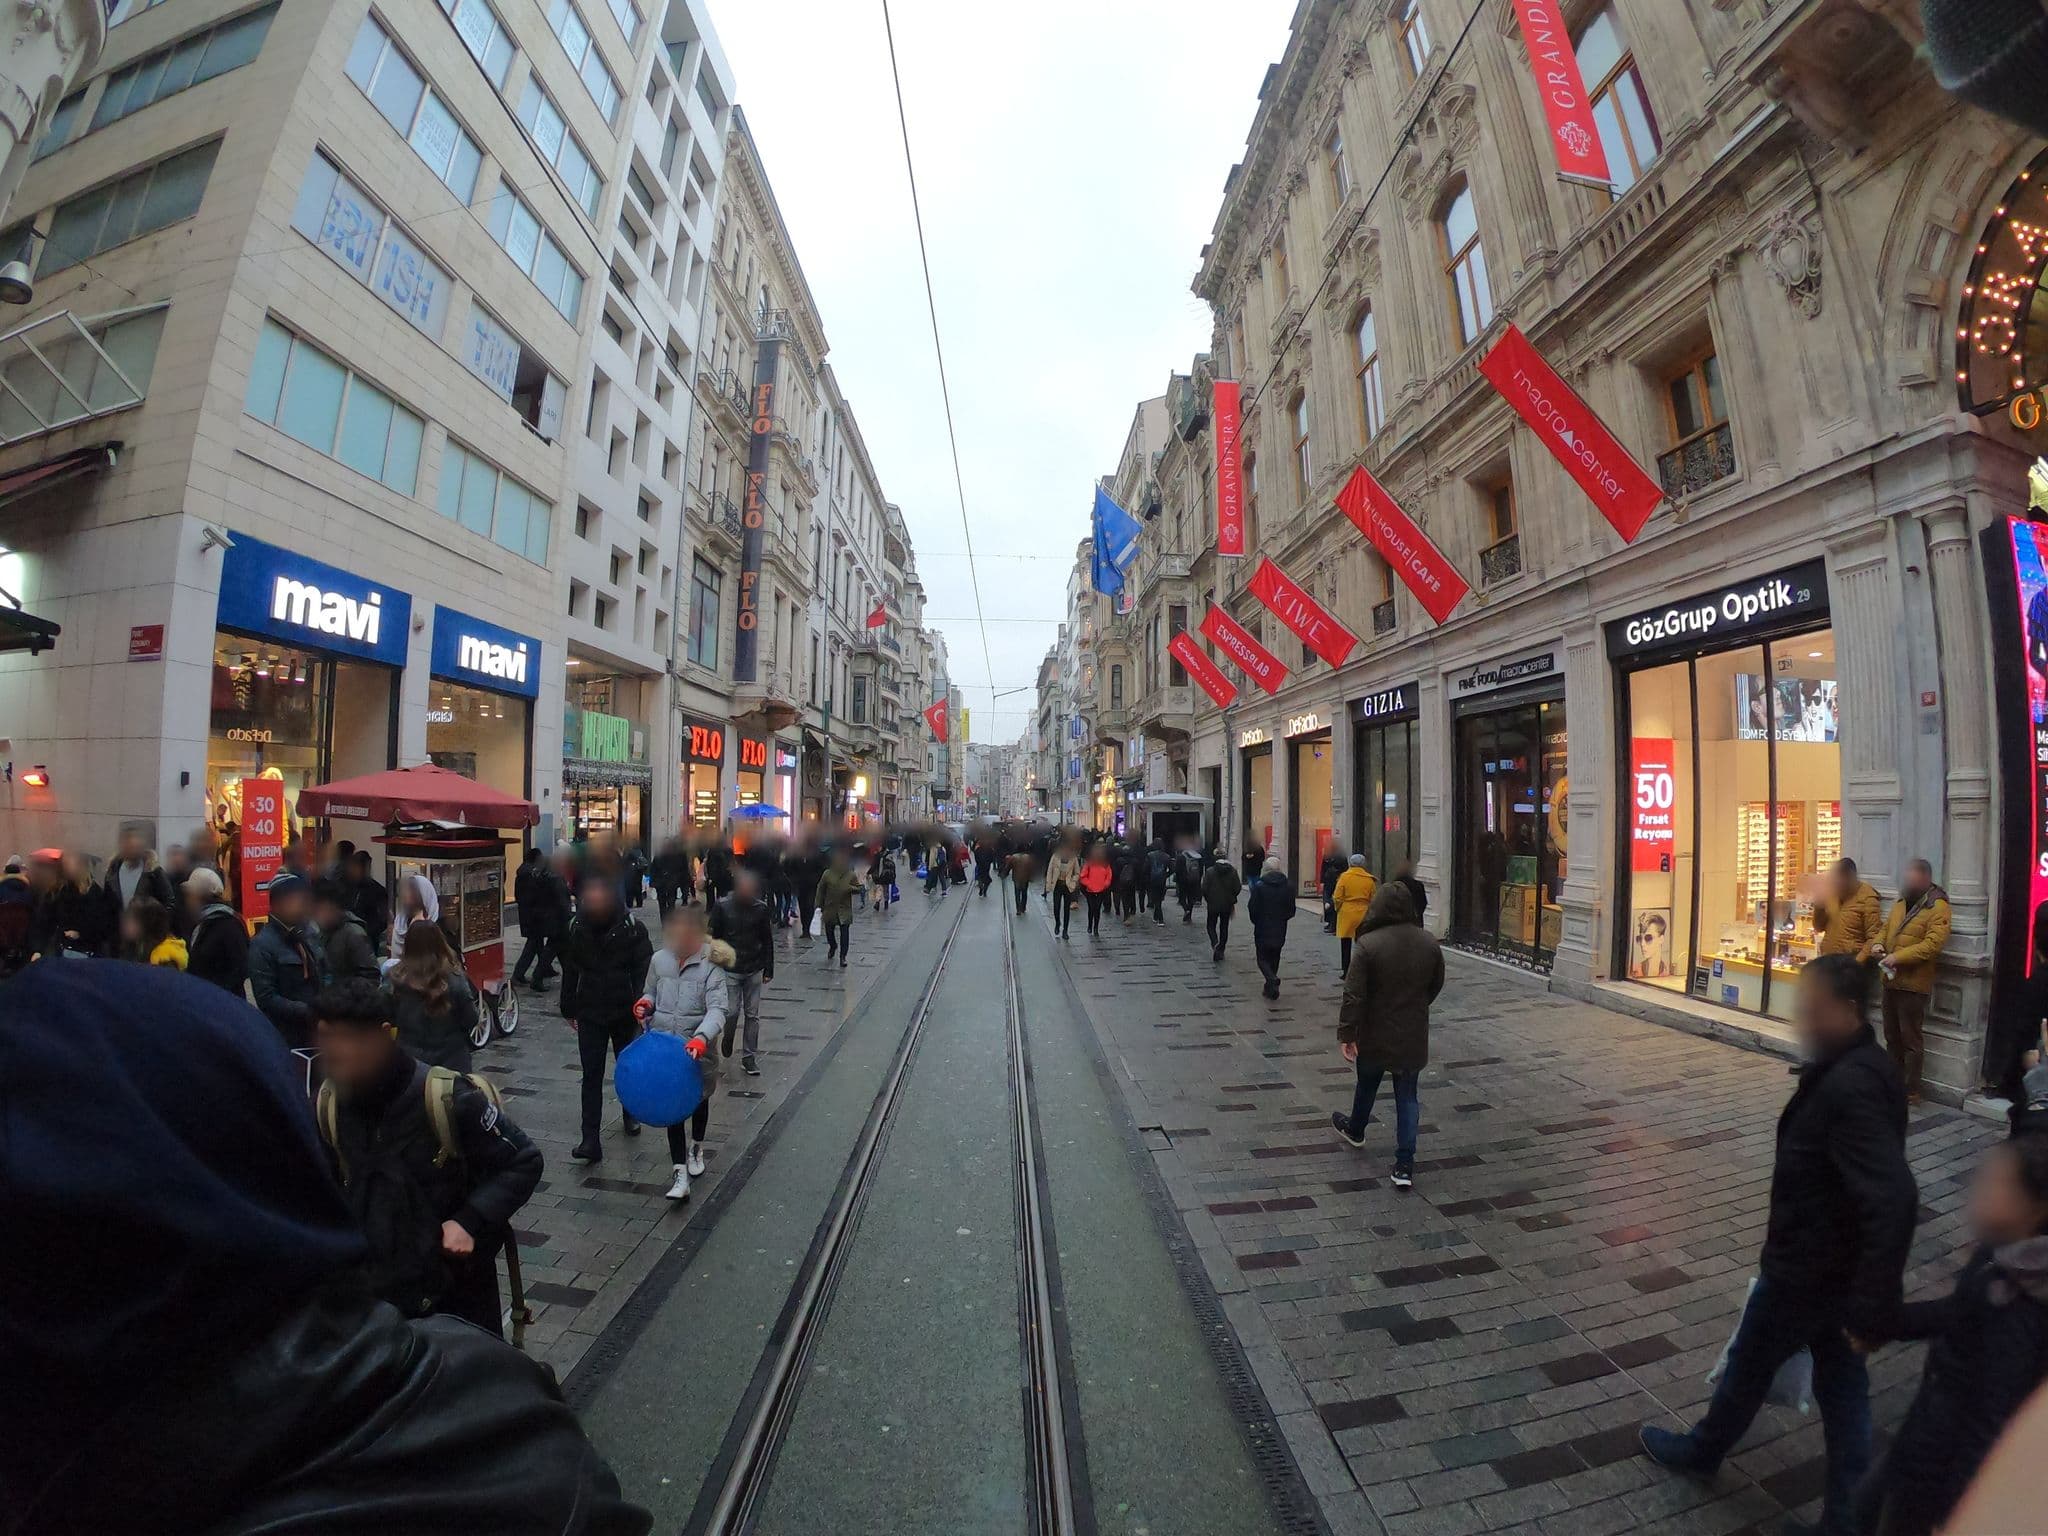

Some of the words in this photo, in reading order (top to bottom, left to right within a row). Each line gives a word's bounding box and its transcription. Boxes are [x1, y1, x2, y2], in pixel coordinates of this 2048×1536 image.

[1523, 0, 1576, 109] GRAND
[753, 383, 774, 435] FLO
[1512, 368, 1567, 432] macro
[1572, 439, 1626, 500] center
[745, 471, 766, 529] FLO
[271, 575, 382, 645] mavi
[738, 571, 758, 631] FLO
[1273, 585, 1329, 645] KIWE
[1626, 605, 1717, 645] GözGrup
[1722, 579, 1794, 622] Optik
[457, 634, 527, 683] mavi
[1288, 712, 1318, 736] DeFacto
[1363, 689, 1405, 717] GIZIA
[690, 725, 722, 759] FLO
[741, 738, 767, 767] FLO
[1758, 728, 1782, 740] FOD
